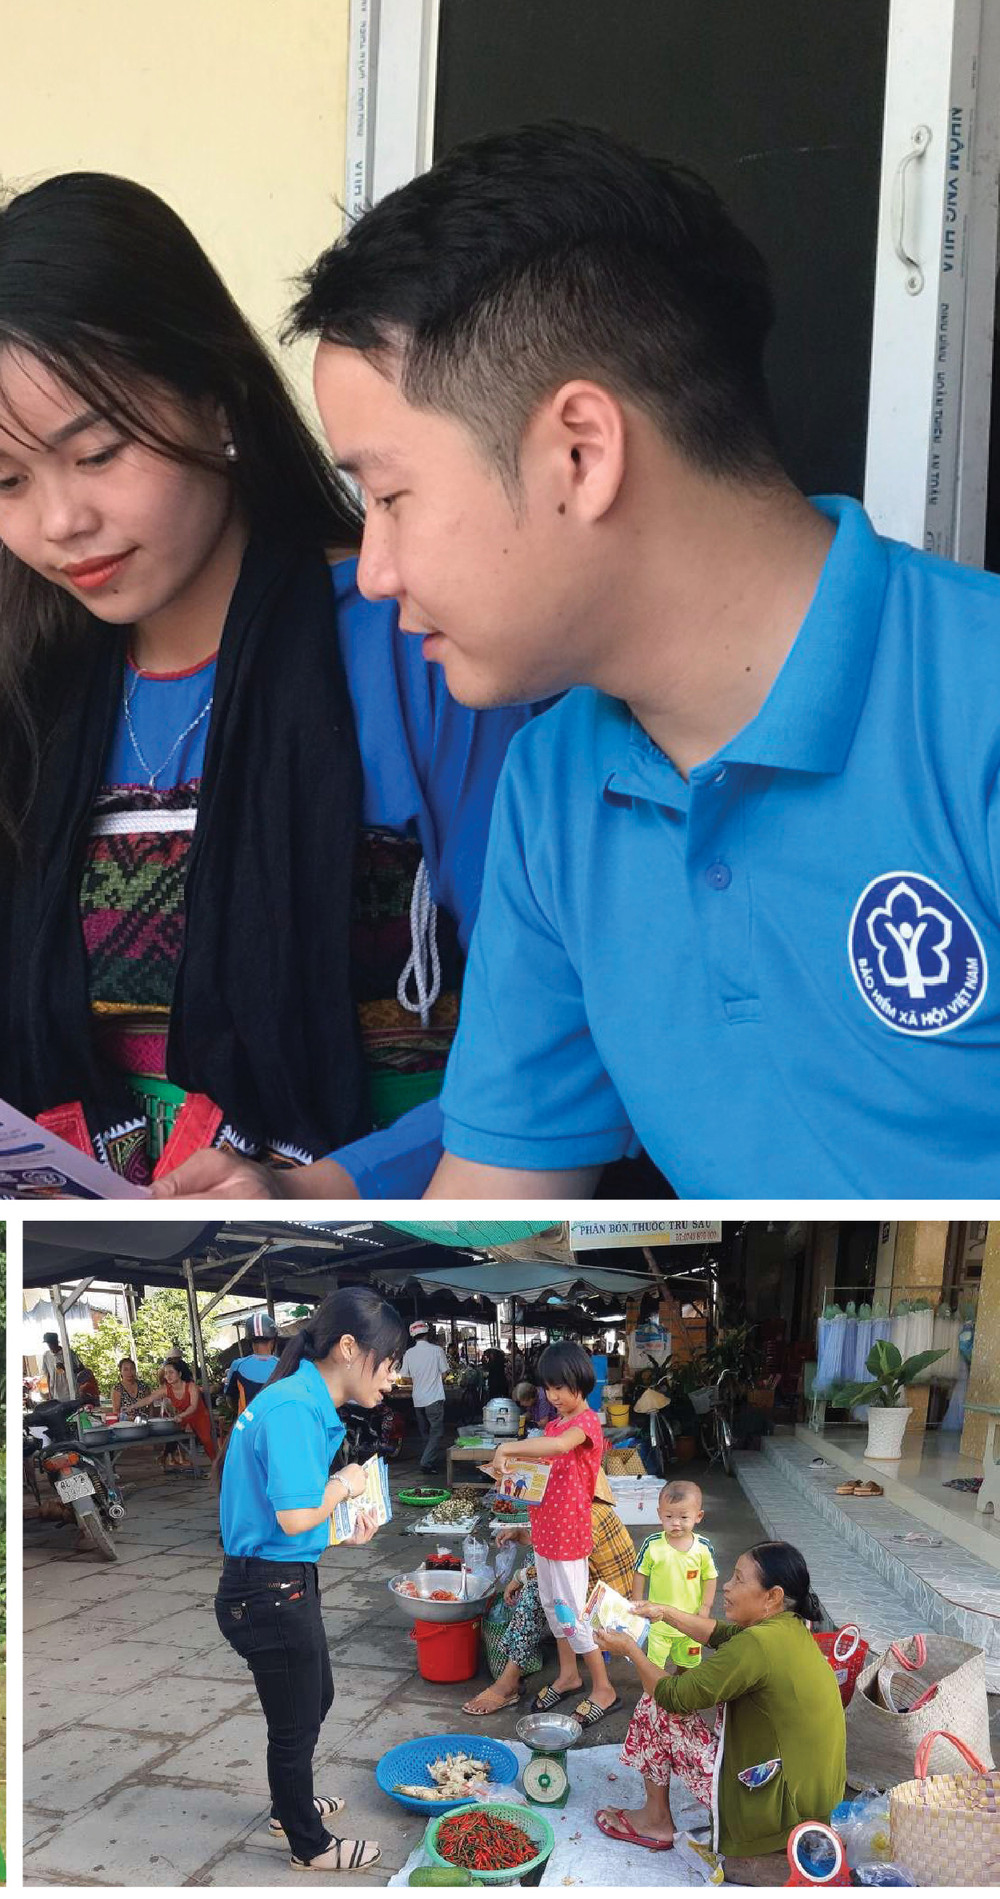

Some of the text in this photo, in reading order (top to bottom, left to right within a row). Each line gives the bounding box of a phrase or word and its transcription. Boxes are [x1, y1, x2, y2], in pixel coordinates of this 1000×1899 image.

[872, 989, 896, 1018] HIỂM
[899, 1009, 918, 1026] XÃ
[920, 1007, 948, 1027] HỘI
[947, 988, 972, 1014] VIỆT
[964, 957, 979, 990] NAM
